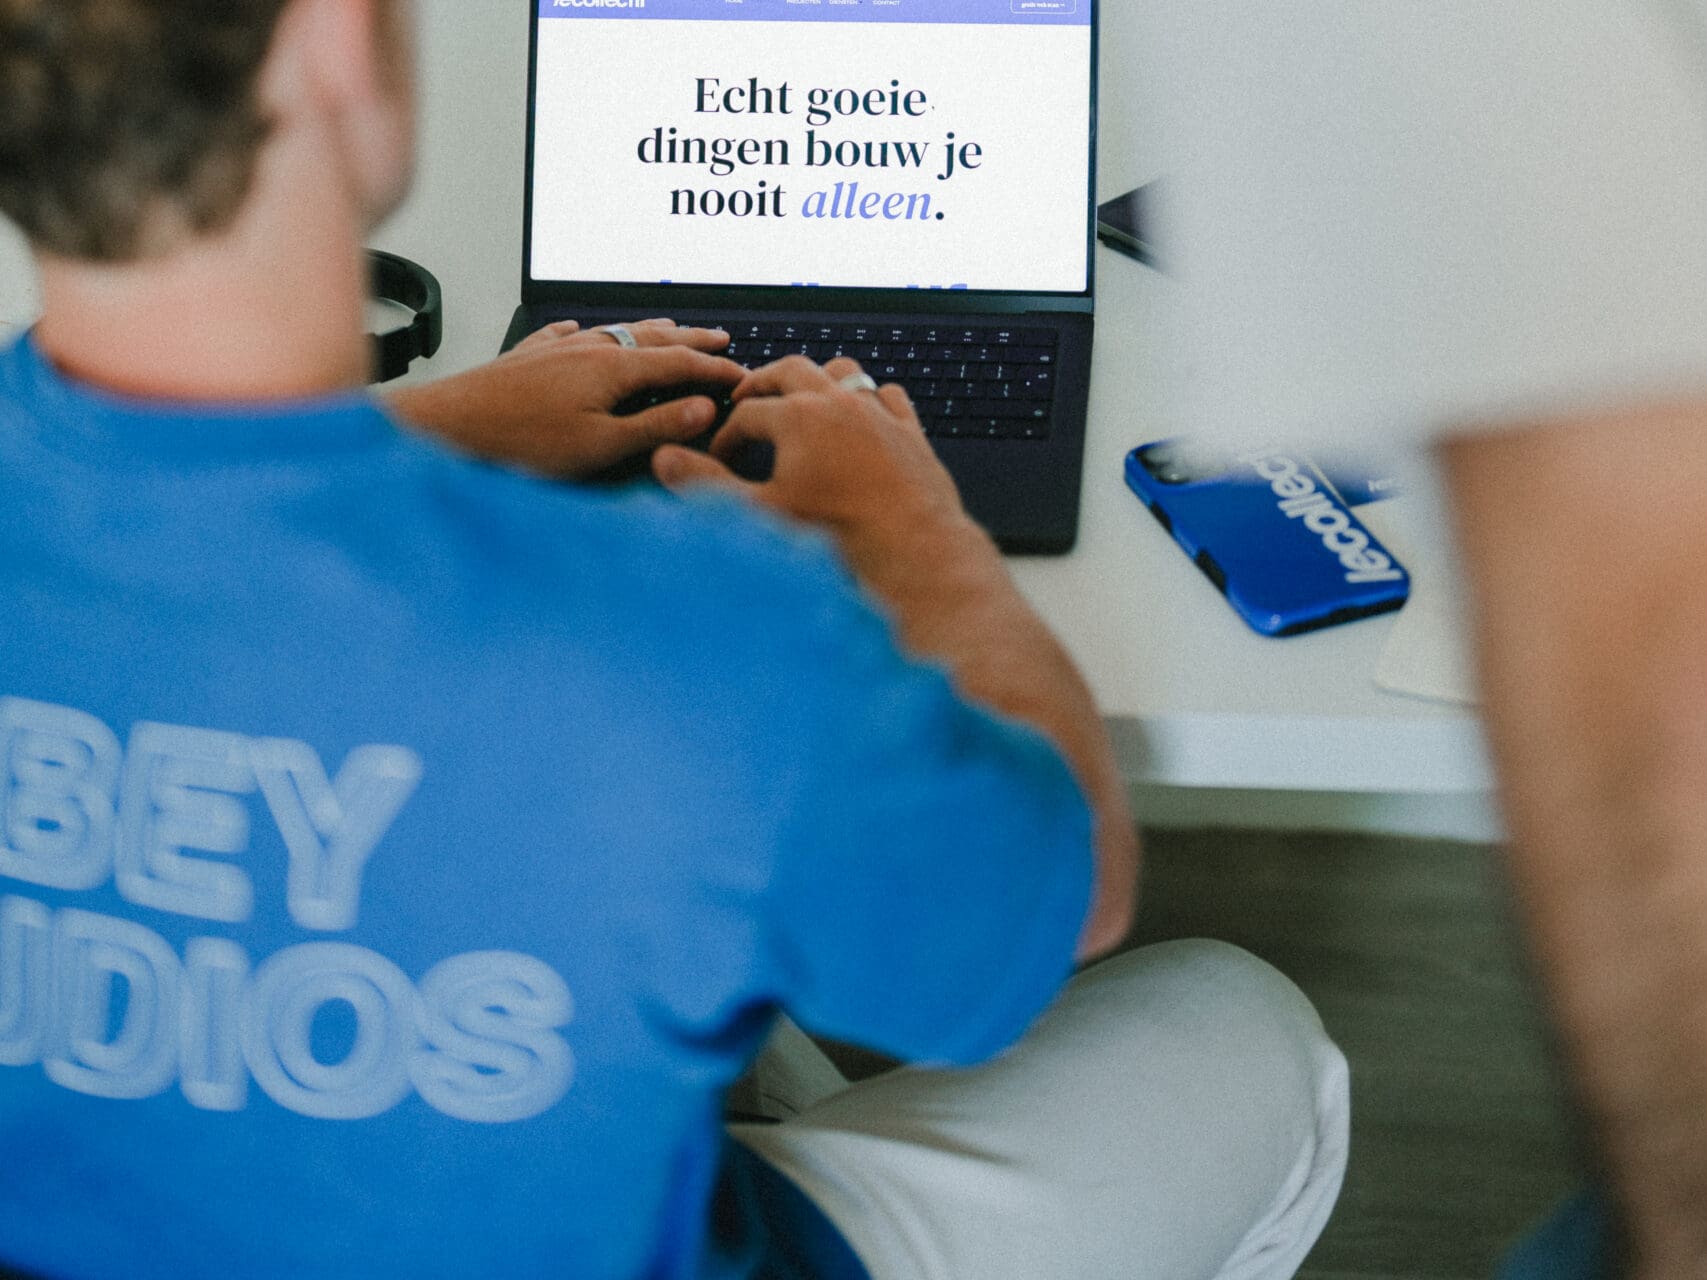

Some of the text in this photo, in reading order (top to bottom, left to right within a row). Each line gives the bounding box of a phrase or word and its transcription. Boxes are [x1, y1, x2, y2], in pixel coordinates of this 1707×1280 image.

[694, 77, 927, 126] Echt goeie
[637, 127, 983, 181] dingen bouw je
[669, 180, 945, 221] nooit alleen.
